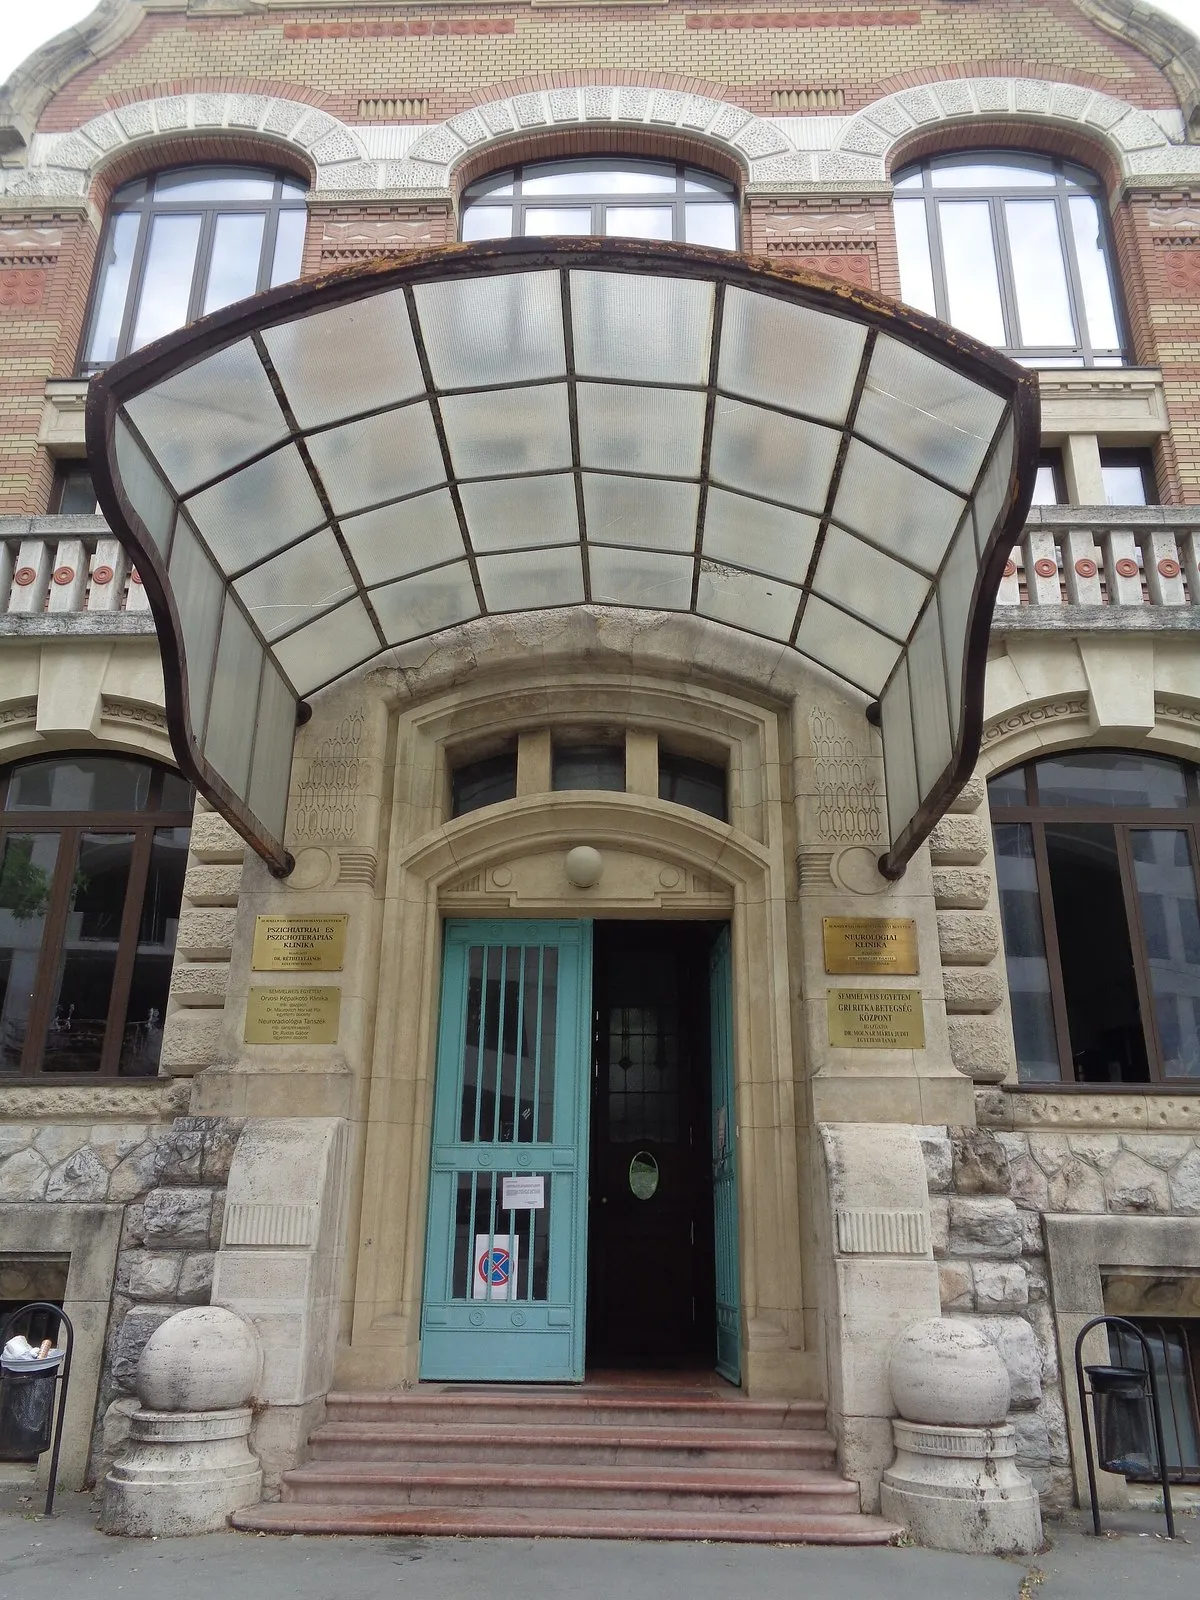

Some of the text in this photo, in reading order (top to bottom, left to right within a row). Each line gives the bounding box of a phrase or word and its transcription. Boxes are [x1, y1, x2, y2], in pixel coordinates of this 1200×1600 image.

[853, 1004, 874, 1012] RITKA
[876, 1003, 912, 1012] BETEGSÉG
[859, 1013, 892, 1021] KÖZPONT
